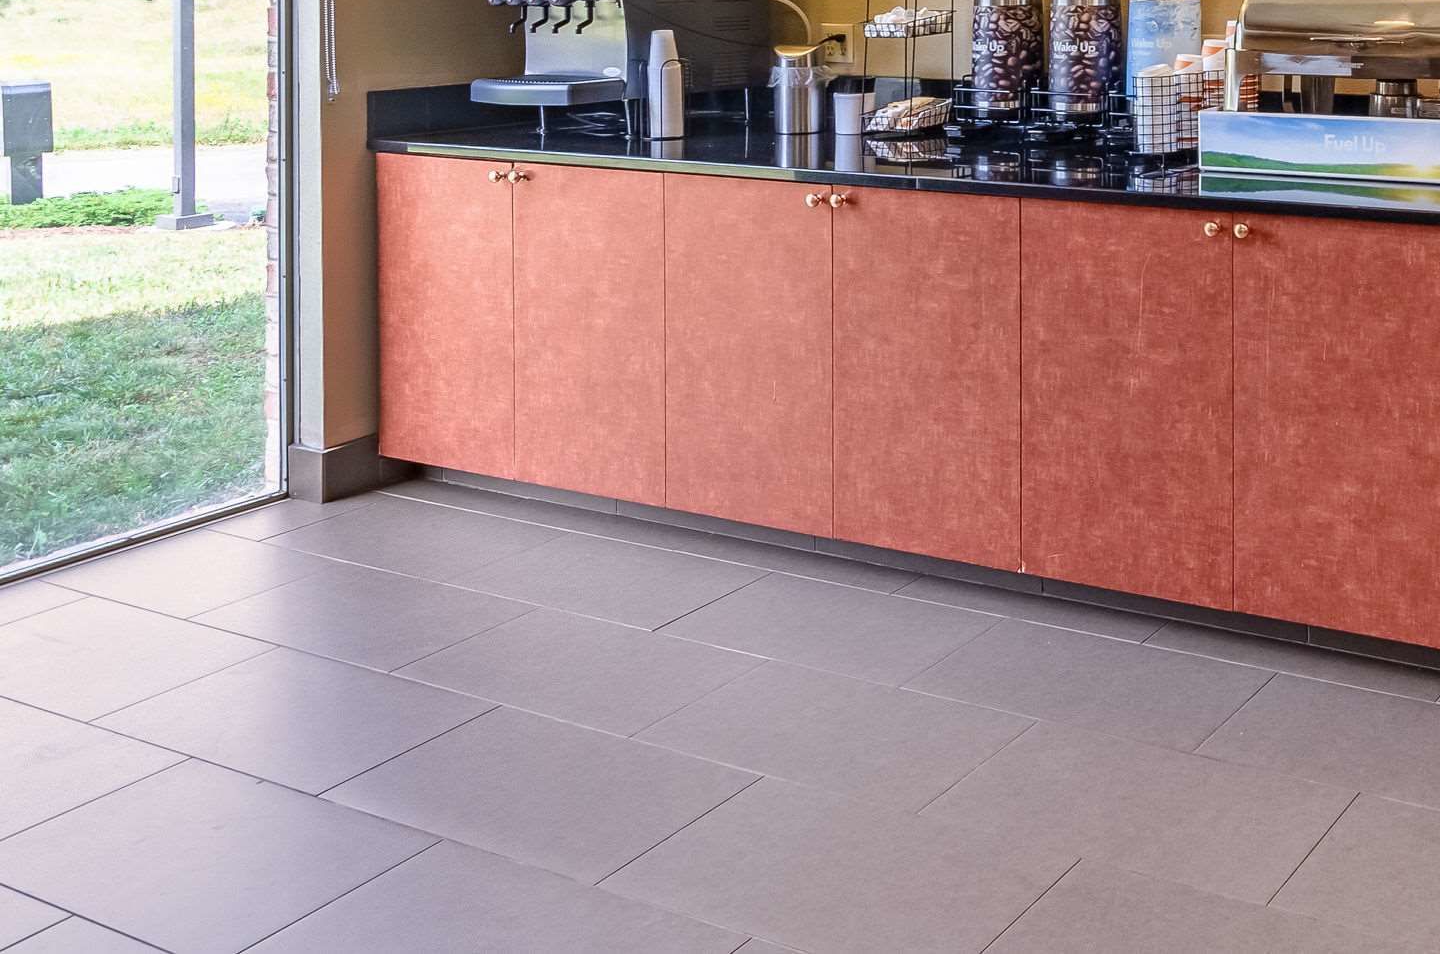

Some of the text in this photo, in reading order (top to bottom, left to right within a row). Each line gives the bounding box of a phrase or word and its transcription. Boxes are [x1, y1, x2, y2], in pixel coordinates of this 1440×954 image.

[989, 40, 1005, 54] Up
[1053, 40, 1096, 54] Wake Up
[1323, 133, 1386, 155] Fuel Up
